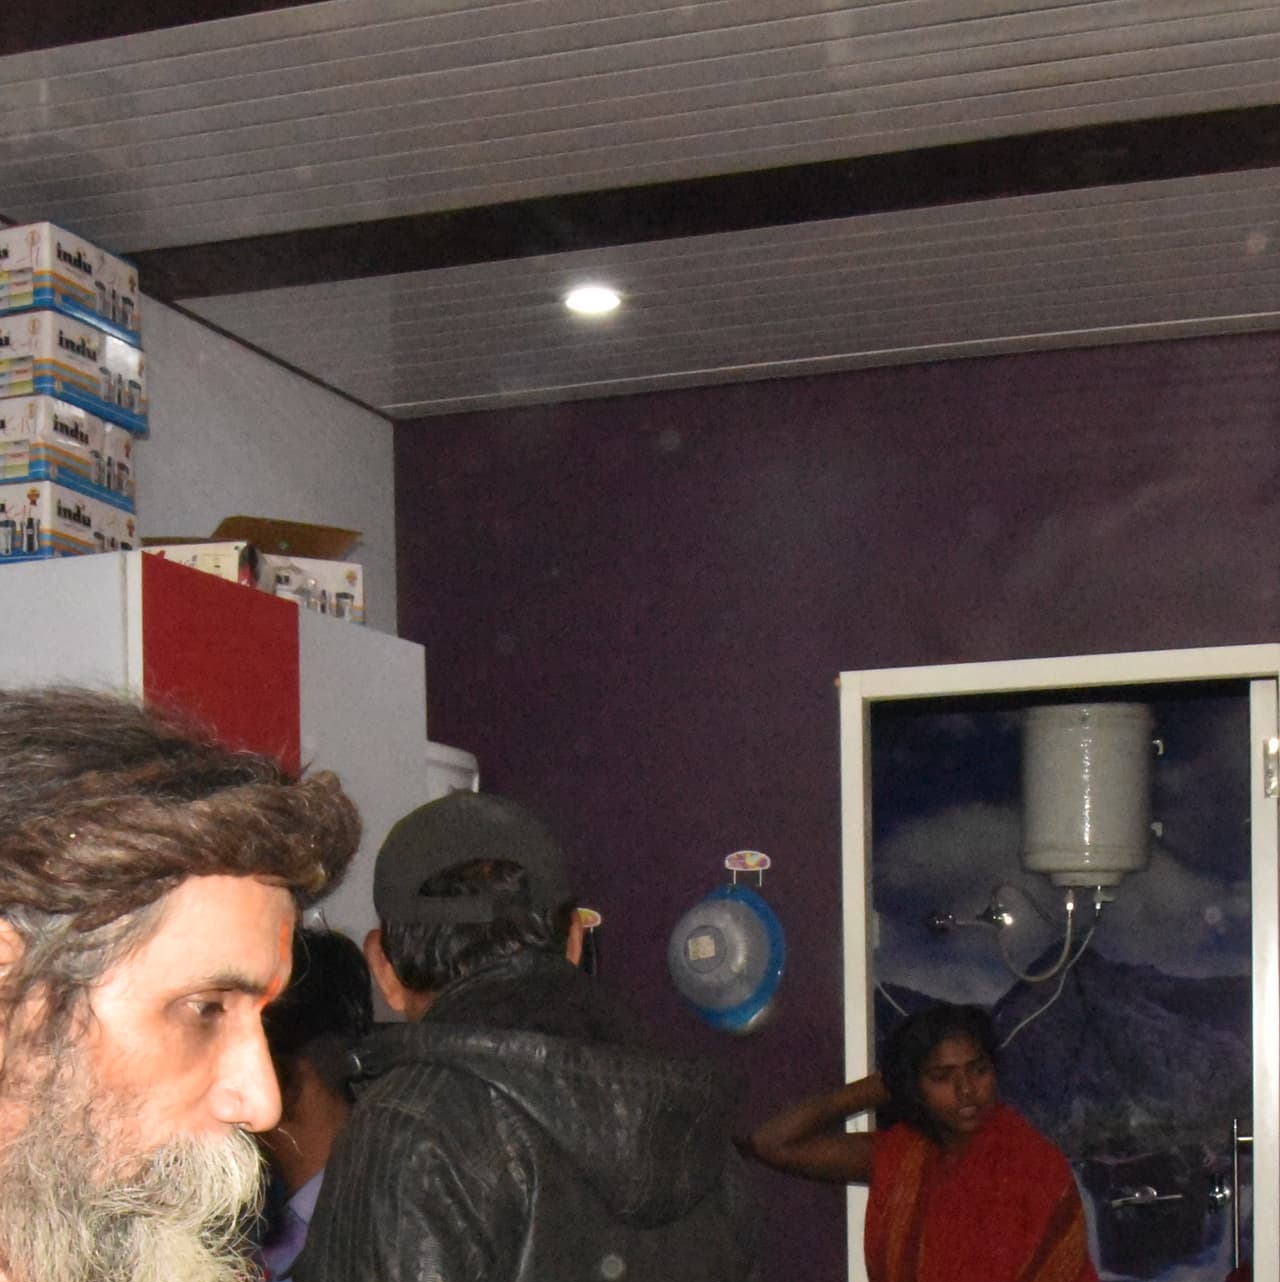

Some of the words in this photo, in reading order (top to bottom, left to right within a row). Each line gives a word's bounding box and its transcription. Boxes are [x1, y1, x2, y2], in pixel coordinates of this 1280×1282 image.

[57, 242, 92, 275] indu
[59, 330, 97, 361] indu
[53, 413, 89, 445] indu
[57, 499, 91, 528] indu
